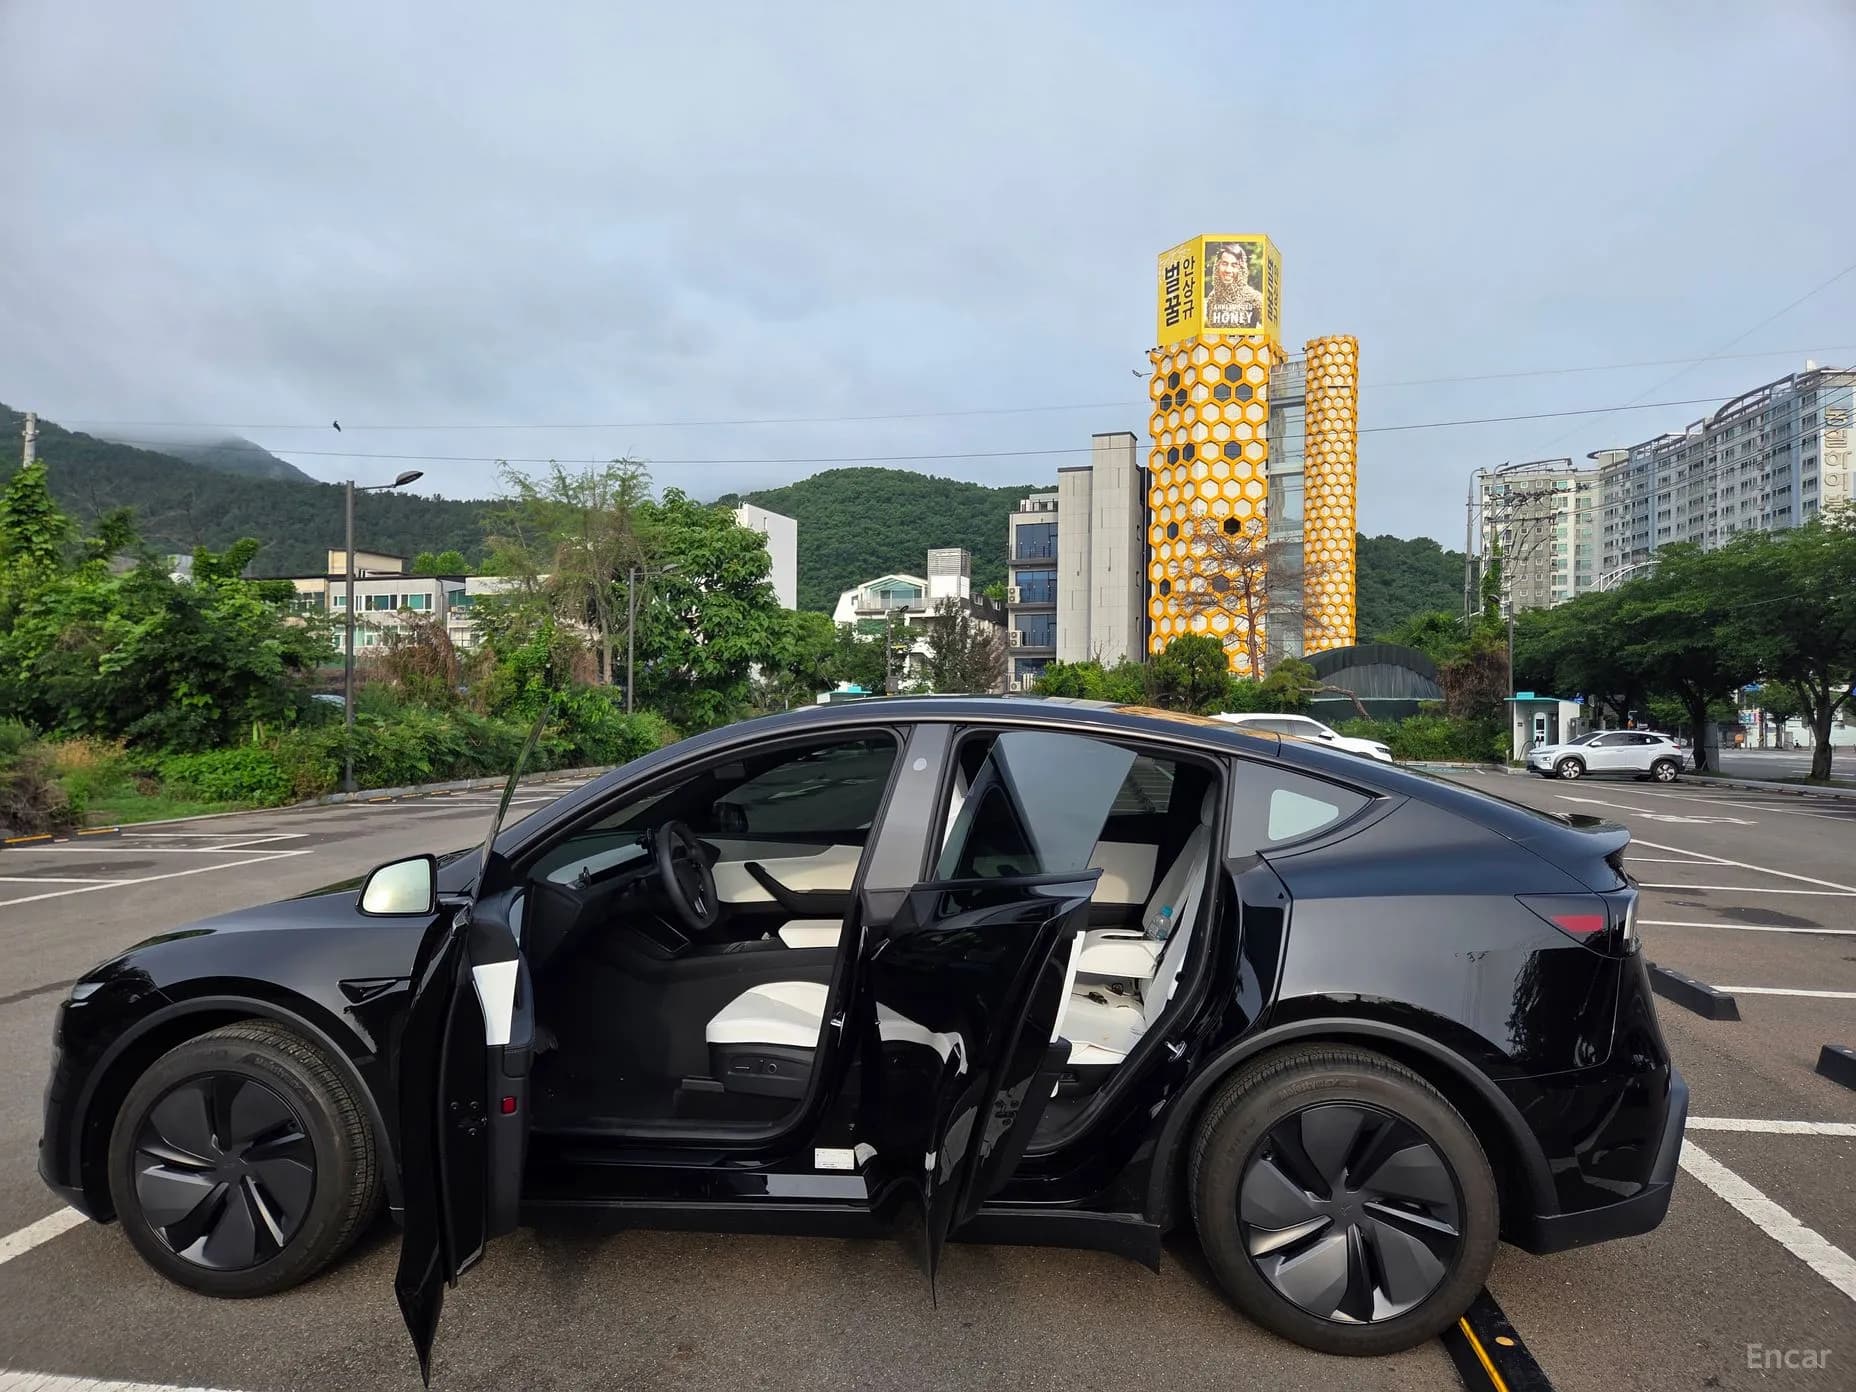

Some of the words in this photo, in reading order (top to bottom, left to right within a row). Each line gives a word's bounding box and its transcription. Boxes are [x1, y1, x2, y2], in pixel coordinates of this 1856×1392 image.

[1164, 261, 1181, 327] 벌꿀
[1183, 255, 1196, 321] 안상규
[1213, 311, 1253, 324] HONEY
